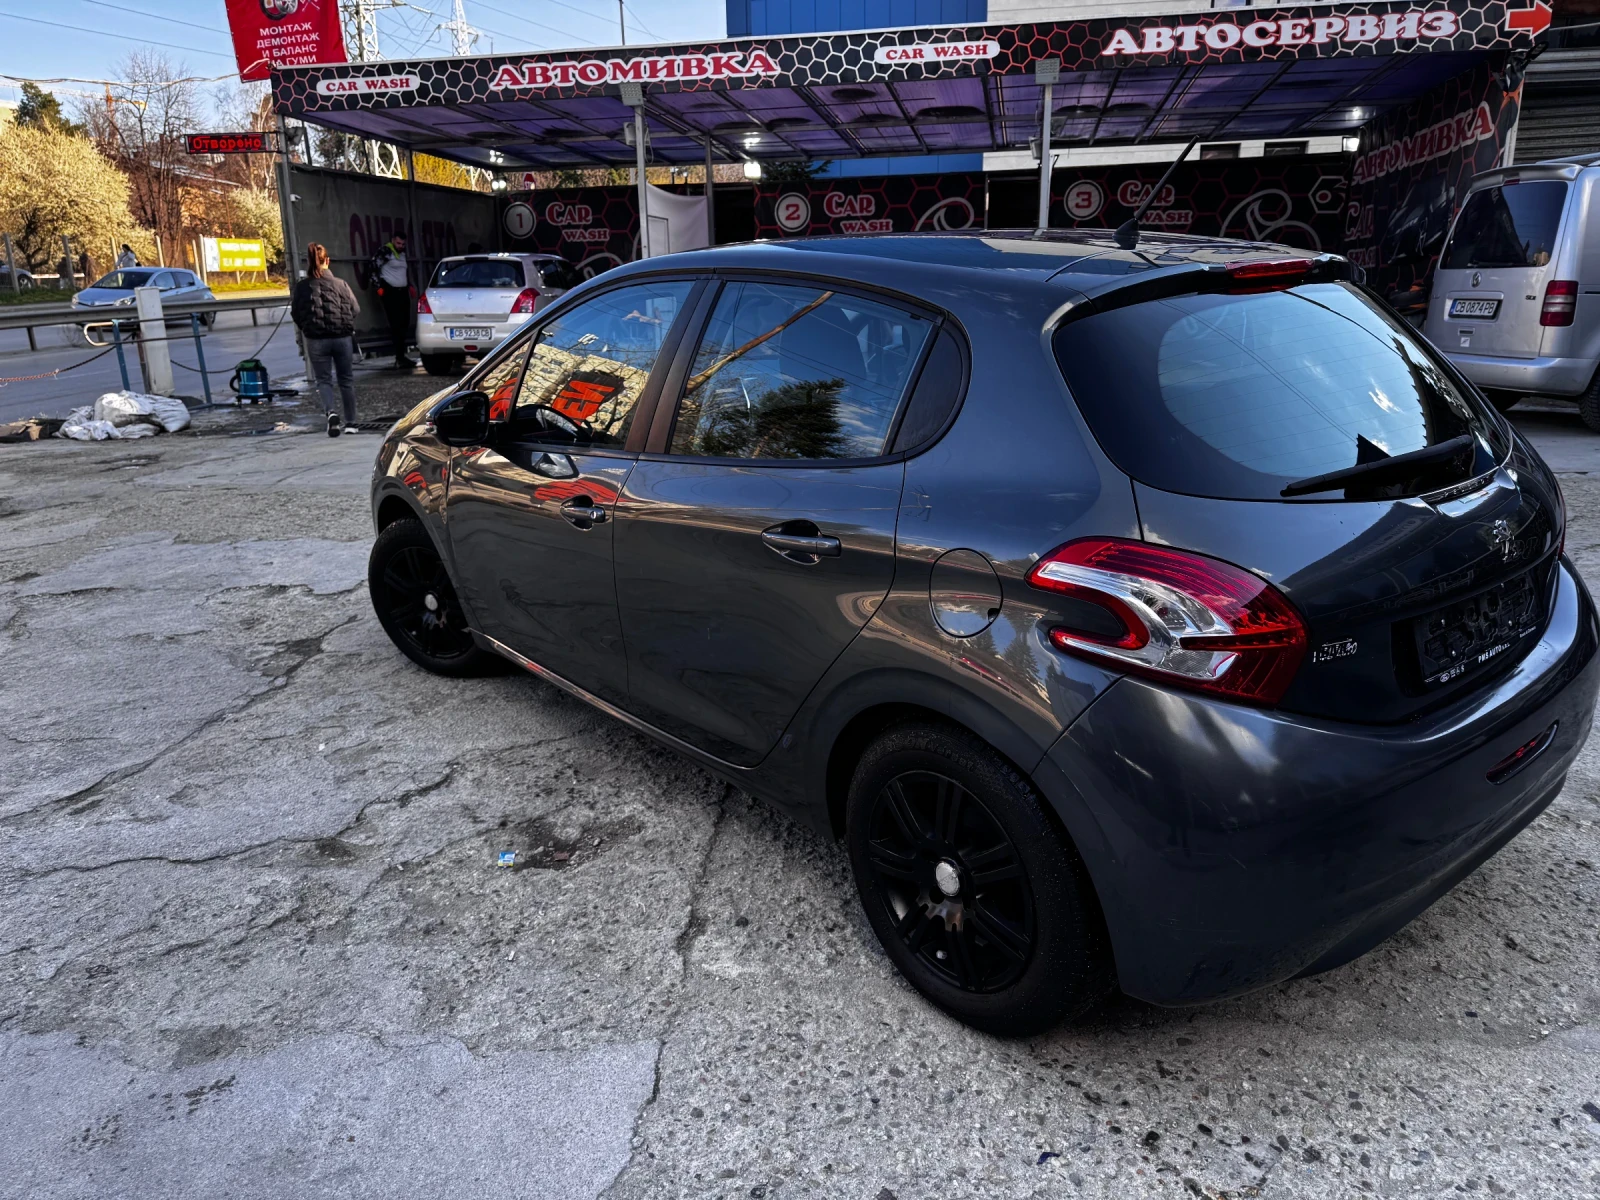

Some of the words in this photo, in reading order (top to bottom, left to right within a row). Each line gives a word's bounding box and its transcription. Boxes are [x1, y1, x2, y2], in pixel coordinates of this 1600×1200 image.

[260, 22, 312, 36] МОНТАЖ
[1102, 11, 1458, 55] АВТОСЕРВИЗ
[257, 33, 320, 48] ДЕМОНТАЖ
[262, 48, 270, 58] И
[272, 43, 317, 58] БАЛАНС
[886, 48, 928, 61] CAR
[933, 43, 989, 58] WASH
[286, 55, 317, 67] ГУМИ
[491, 51, 779, 88] АВТОМИВКА
[325, 81, 359, 92] CAR
[364, 77, 411, 91] WASH
[193, 137, 261, 150] Отворено
[1352, 101, 1495, 186] АВТОМИВКА
[1075, 191, 1092, 209] 3
[1117, 180, 1175, 206] CAR
[785, 204, 800, 221] 2
[824, 192, 875, 217] CAR
[516, 213, 524, 229] 1
[546, 202, 592, 225] CAR
[1141, 209, 1192, 225] WASH
[840, 219, 893, 234] WASH
[563, 229, 610, 243] WASH
[1465, 302, 1483, 314] 0874
